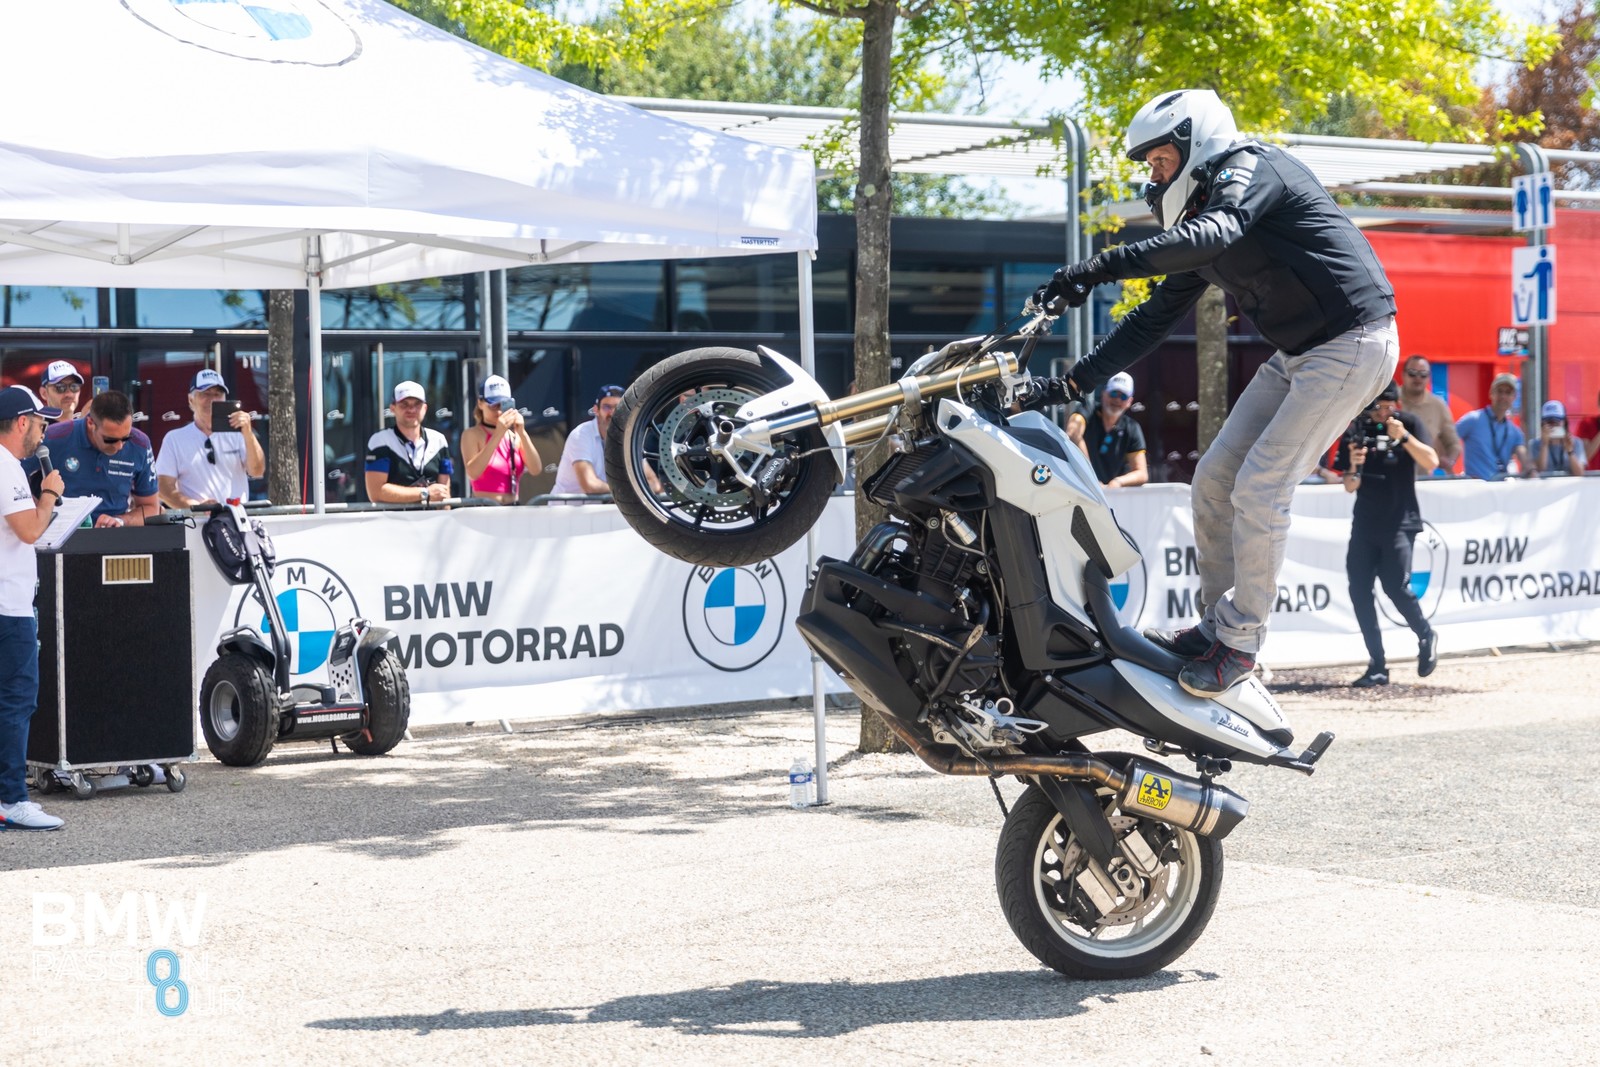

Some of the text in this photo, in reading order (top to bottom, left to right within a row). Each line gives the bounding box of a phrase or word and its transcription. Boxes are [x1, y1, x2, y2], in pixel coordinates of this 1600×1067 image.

[762, 460, 780, 483] brembo
[1165, 546, 1200, 576] BM
[1463, 536, 1528, 565] BMW
[384, 581, 493, 621] BMW
[386, 622, 625, 669] MOTORRAD
[1140, 794, 1166, 808] ARROW
